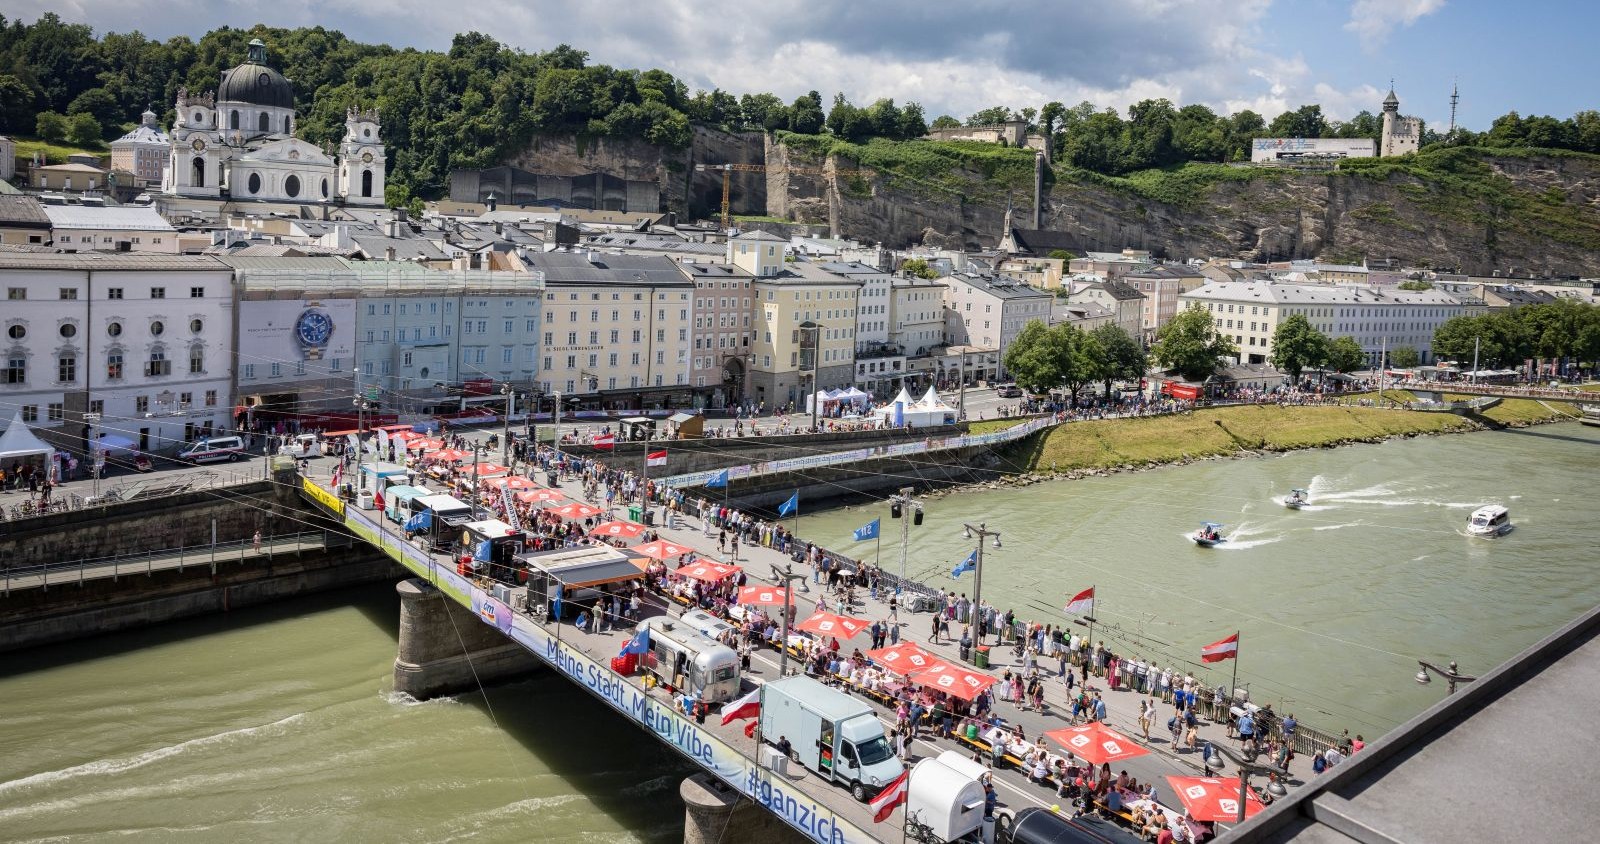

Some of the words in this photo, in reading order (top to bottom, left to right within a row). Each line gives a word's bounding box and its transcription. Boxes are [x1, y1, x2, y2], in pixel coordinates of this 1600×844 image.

[547, 636, 584, 680] Meine
[587, 663, 629, 711] Stadt.
[632, 691, 672, 734] Mein
[675, 717, 719, 770] Vibe.
[747, 766, 845, 844] #ganzich
